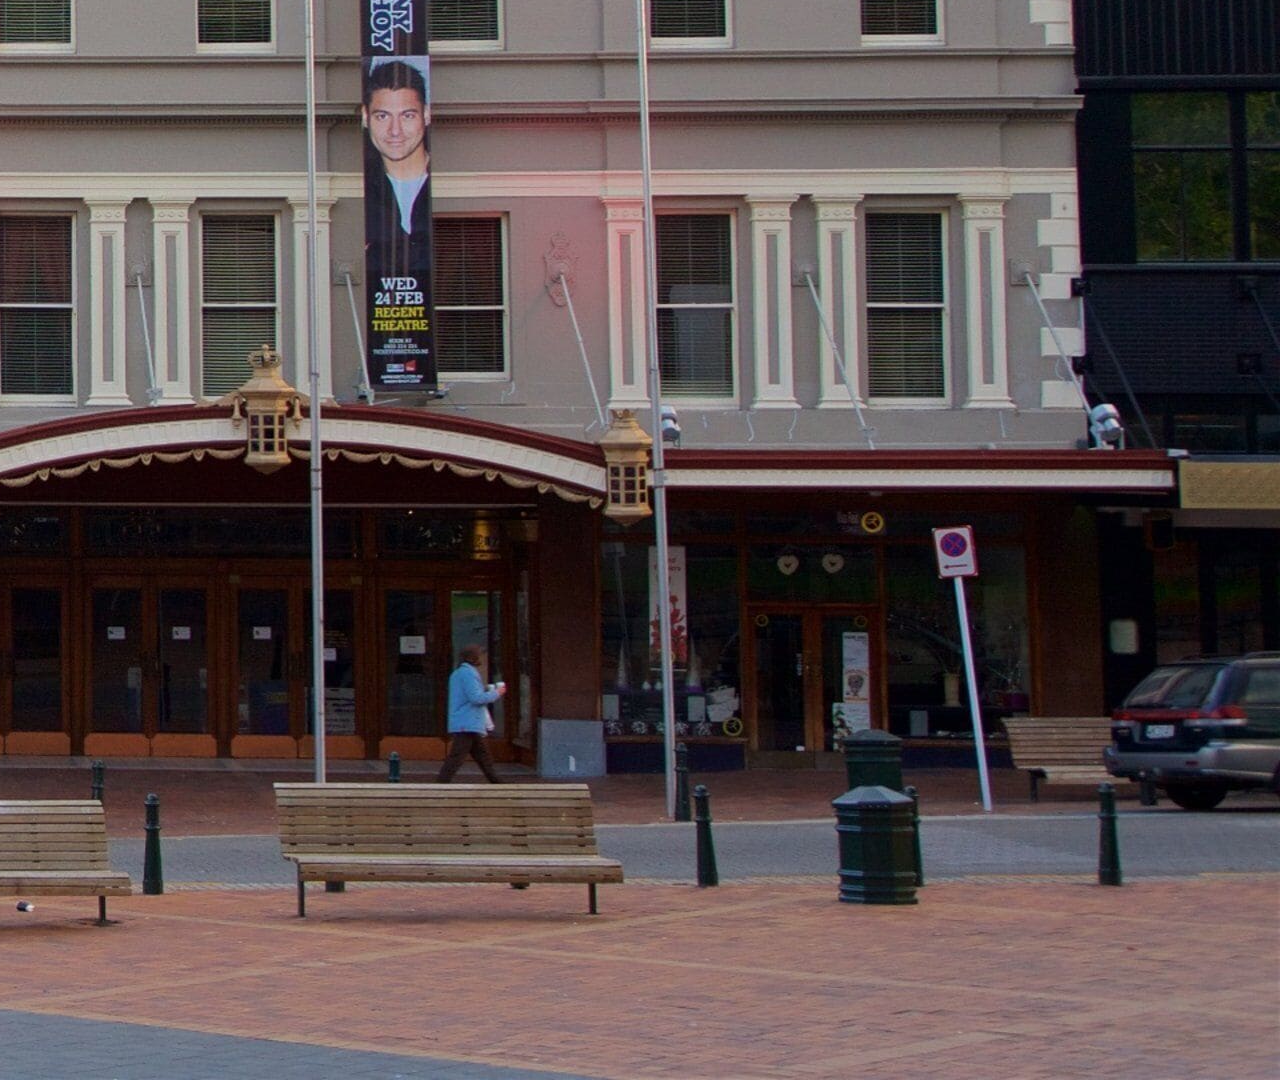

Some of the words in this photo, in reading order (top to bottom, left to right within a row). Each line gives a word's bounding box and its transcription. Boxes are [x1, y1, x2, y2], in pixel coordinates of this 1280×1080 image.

[381, 277, 417, 290] WED
[375, 292, 391, 305] 24
[395, 291, 424, 305] FEB
[374, 307, 425, 318] REGENT
[372, 319, 429, 331] THEATRE
